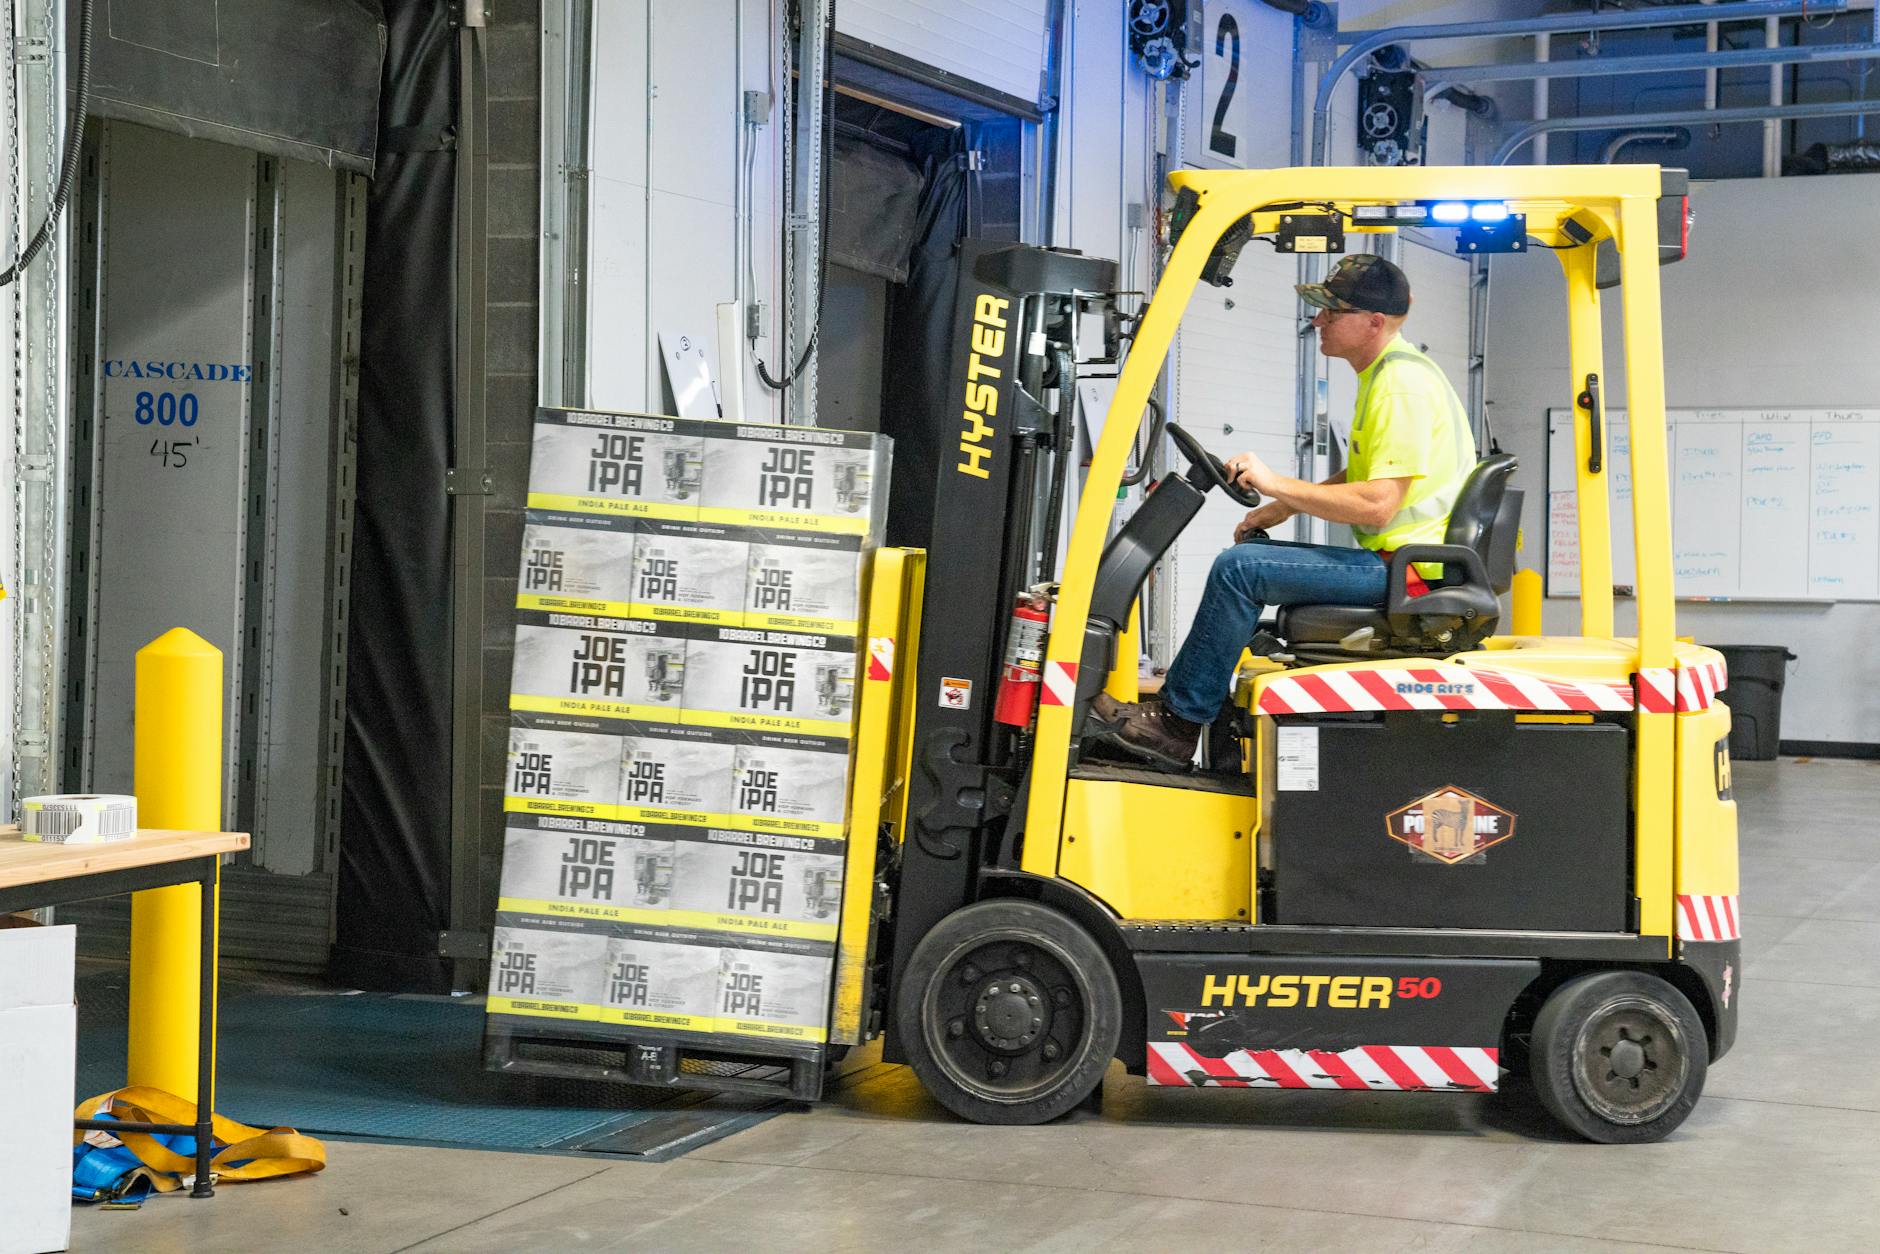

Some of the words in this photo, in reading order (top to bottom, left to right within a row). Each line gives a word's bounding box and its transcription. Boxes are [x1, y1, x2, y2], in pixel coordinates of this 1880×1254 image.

[1210, 13, 1240, 158] 2
[104, 360, 252, 382] CASCADE
[957, 294, 1009, 479] HYSTER
[135, 392, 198, 427] 800
[592, 434, 645, 462] JOE
[762, 448, 815, 476] JOE
[588, 460, 643, 496] IPA
[758, 474, 813, 510] IPA
[608, 502, 629, 511] PALE
[632, 504, 648, 512] ALE
[528, 549, 563, 568] JOE
[642, 559, 677, 577] JOE
[525, 567, 562, 591] IPA
[639, 577, 676, 600] IPA
[756, 569, 792, 587] JOE
[754, 587, 790, 610] IPA
[574, 635, 627, 663] JOE
[744, 650, 797, 678] JOE
[570, 662, 625, 697] IPA
[1396, 683, 1434, 694] RIDE
[740, 676, 795, 712] IPA
[590, 703, 611, 712] PALE
[615, 705, 630, 713] ALE
[760, 718, 781, 727] PALE
[785, 720, 800, 728] ALE
[516, 753, 551, 772] JOE
[629, 761, 665, 780] JOE
[513, 771, 550, 795] IPA
[627, 779, 663, 803] IPA
[742, 770, 778, 789] JOE
[740, 788, 776, 812] IPA
[562, 838, 616, 866] JOE
[732, 852, 785, 880] JOE
[559, 864, 614, 900] IPA
[728, 878, 783, 913] IPA
[579, 906, 600, 915] PALE
[603, 908, 619, 916] ALE
[748, 919, 769, 928] PALE
[773, 922, 788, 930] ALE
[500, 952, 536, 971] JOE
[613, 963, 649, 982] JOE
[498, 970, 534, 994] IPA
[611, 981, 647, 1005] IPA
[726, 973, 762, 992] JOE
[1201, 974, 1393, 1008] HYSTER
[1396, 976, 1442, 1000] 50
[724, 991, 760, 1015] IPA
